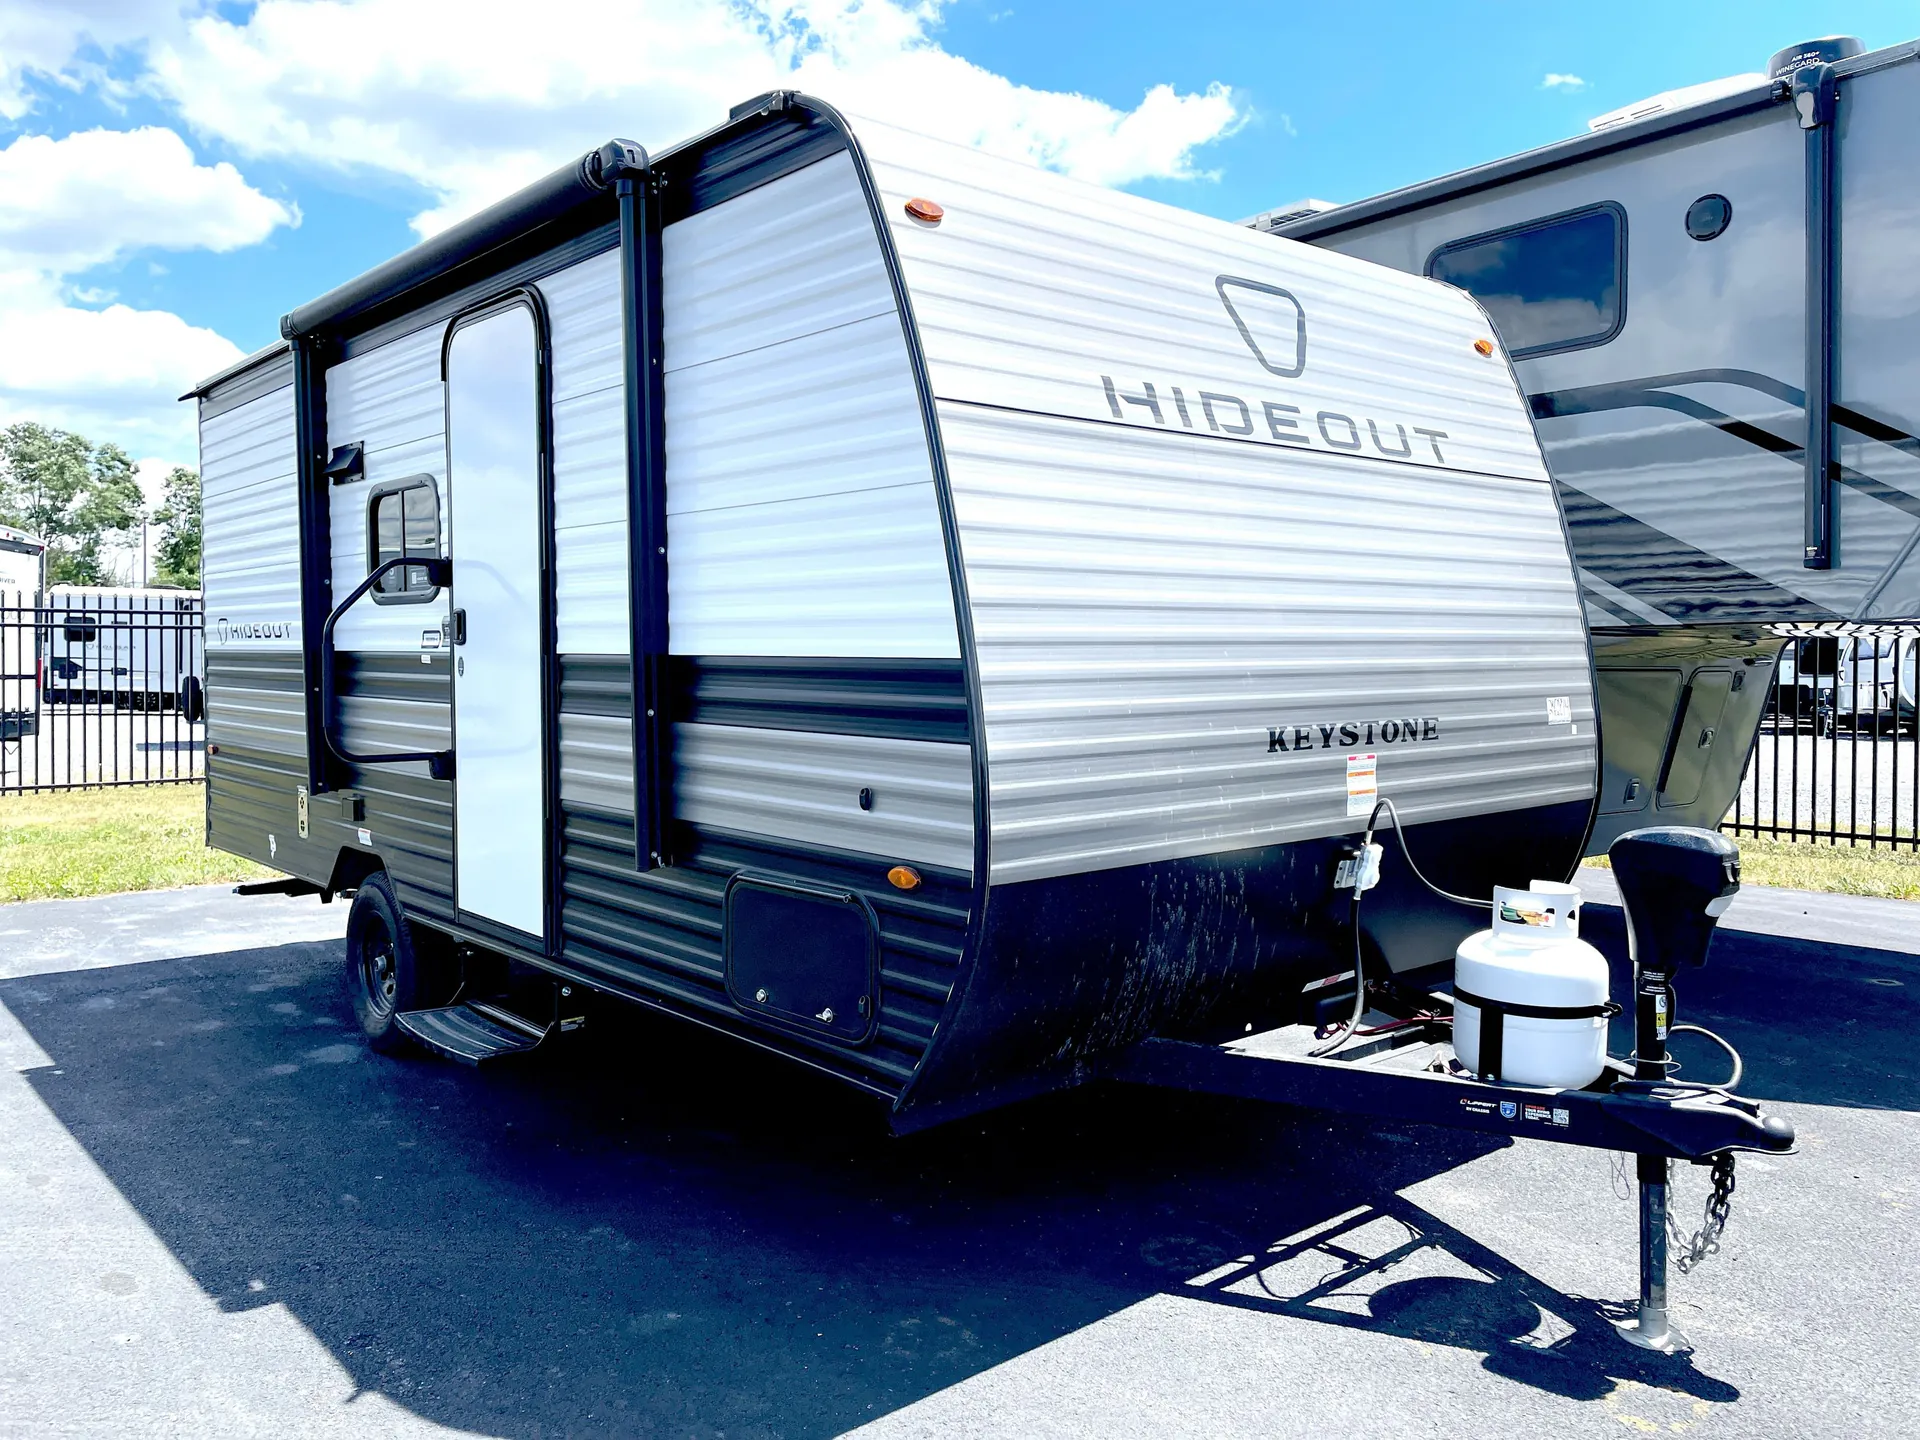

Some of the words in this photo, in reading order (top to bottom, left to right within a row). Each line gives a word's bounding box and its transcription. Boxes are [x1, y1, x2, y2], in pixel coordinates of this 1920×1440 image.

[1775, 57, 1820, 76] WINEGARD
[1100, 375, 1449, 464] HIDEOUT
[230, 622, 292, 639] HIDEOUT
[1266, 717, 1440, 752] KEYSTONE
[1467, 1100, 1497, 1108] LIPPERT
